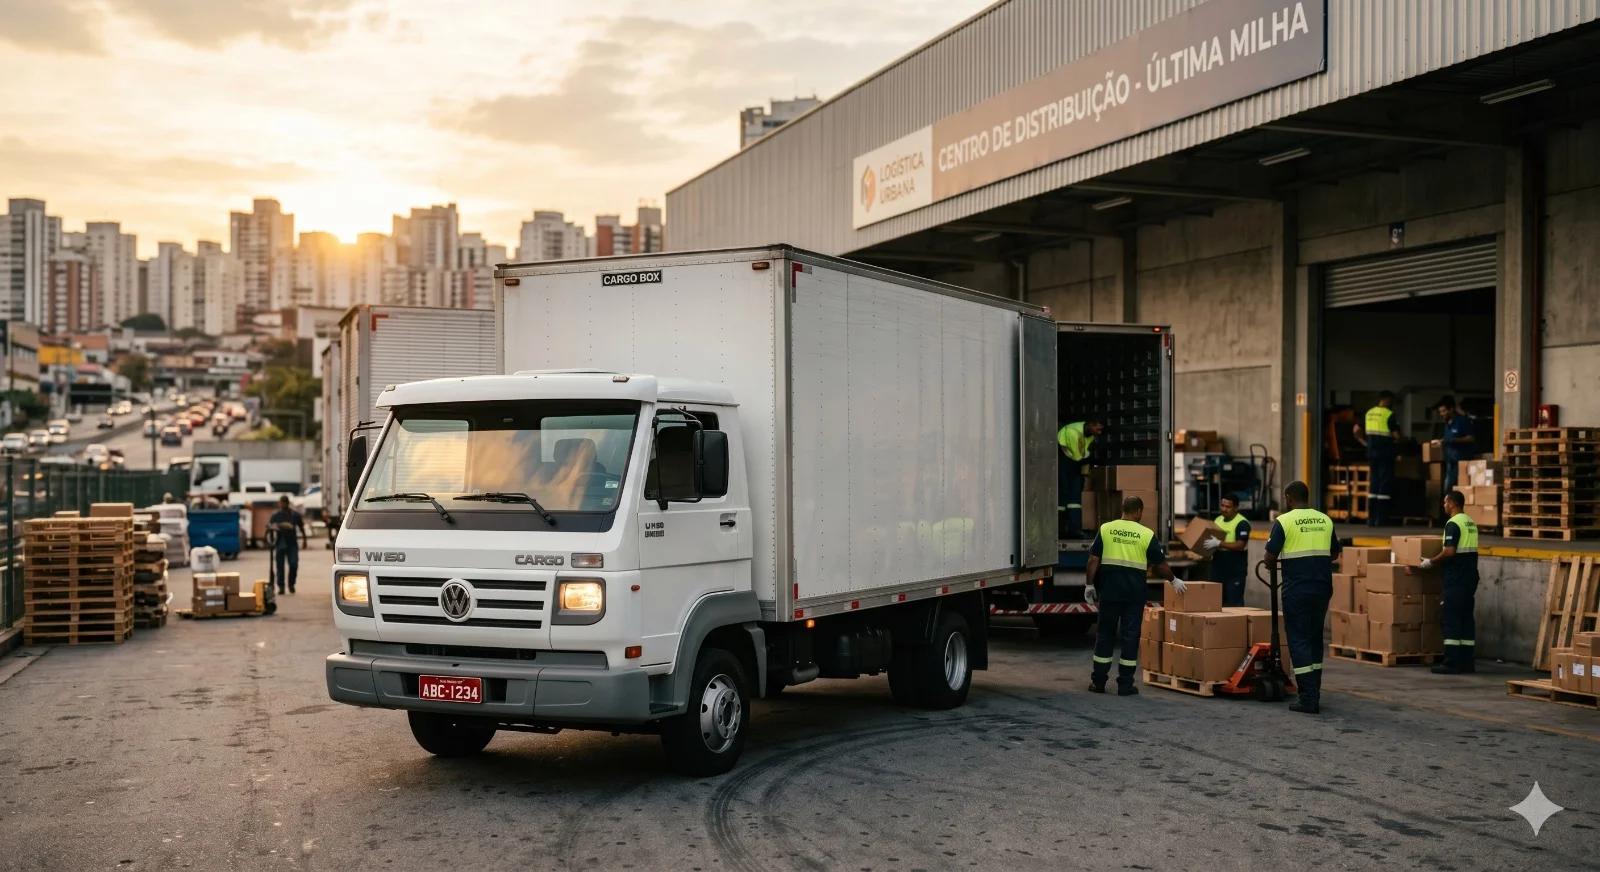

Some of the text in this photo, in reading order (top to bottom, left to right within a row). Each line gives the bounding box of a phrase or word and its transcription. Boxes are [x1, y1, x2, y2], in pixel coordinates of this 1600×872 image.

[939, 130, 989, 172] CENTRO
[992, 124, 1011, 153] DE
[1015, 70, 1130, 144] DISTRIBUIÇÃO
[1147, 51, 1225, 93] ÚLTIMA
[1230, 1, 1309, 62] MILHA
[880, 151, 925, 182] LOGÍSTICA
[880, 177, 916, 204] URBANA
[603, 272, 660, 285] CARGO BOX
[1109, 529, 1141, 539] LOGÍSTICA
[365, 551, 382, 562] VW
[514, 554, 565, 566] CARGO
[422, 683, 479, 700] ABC-1234
